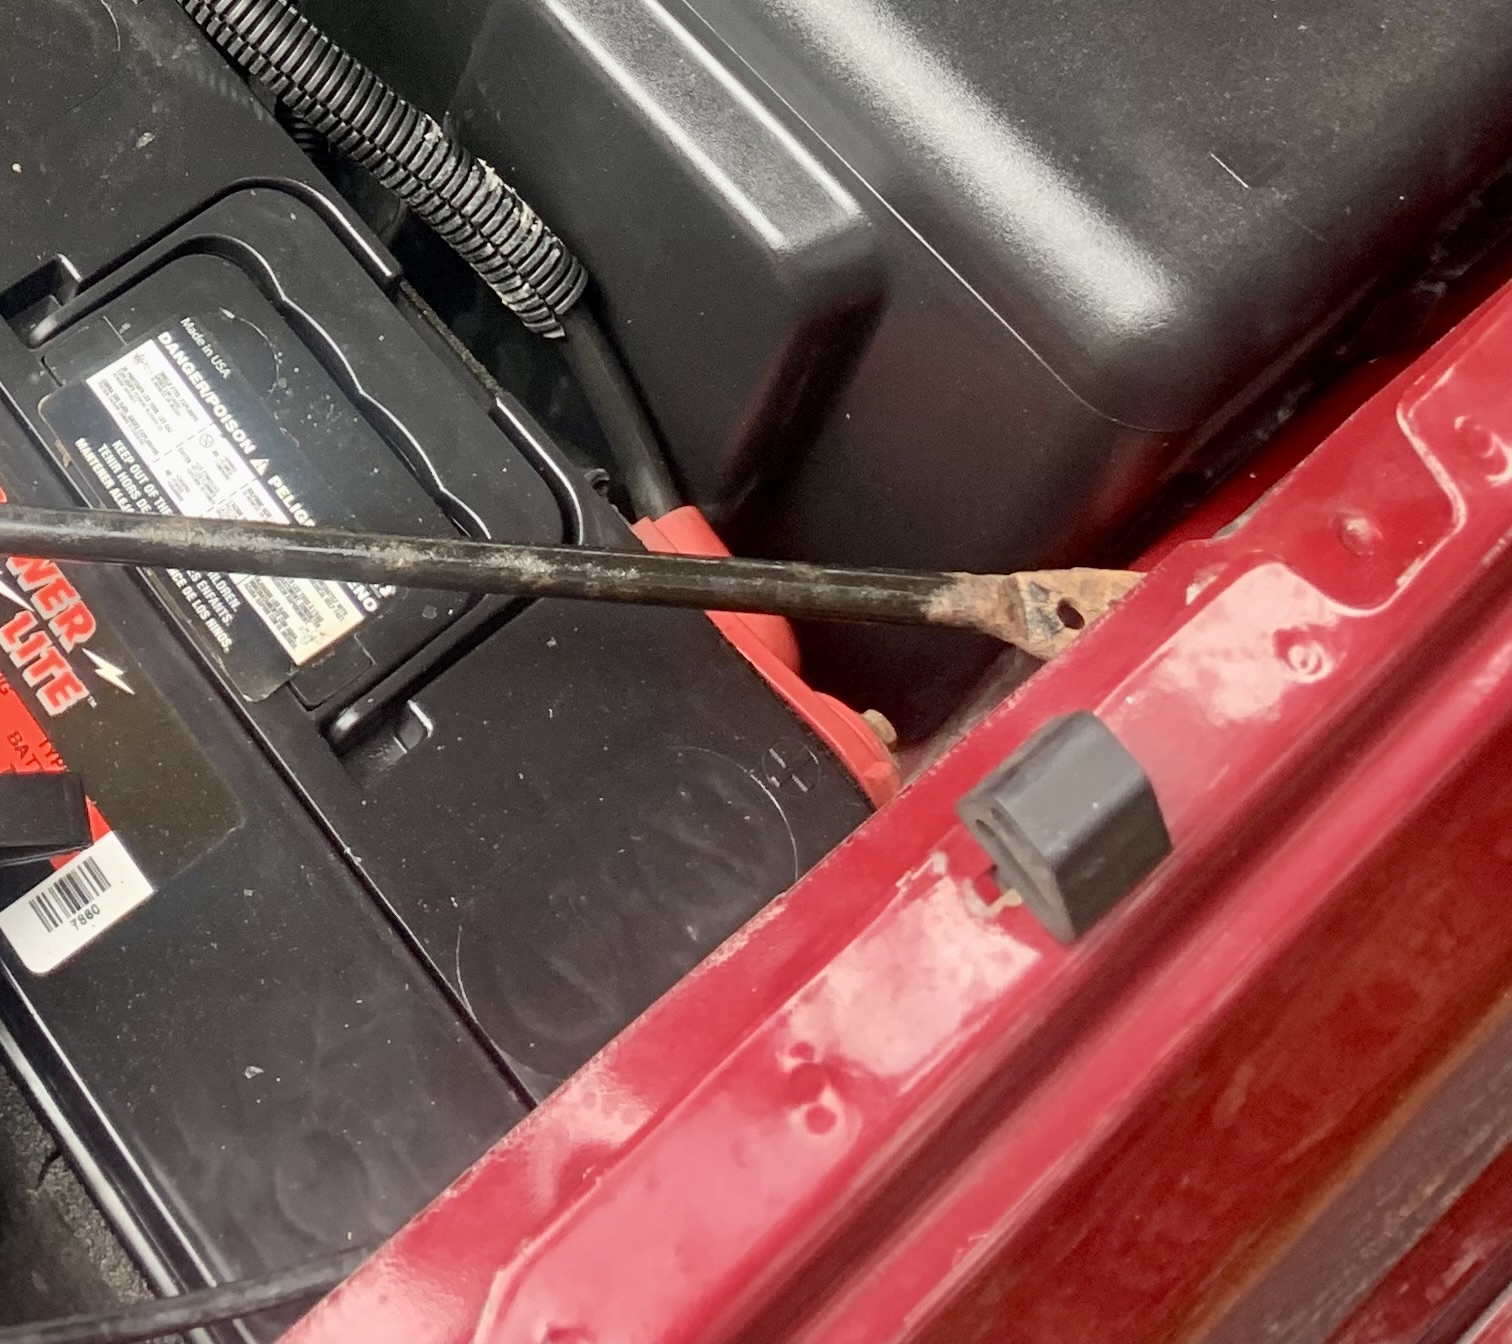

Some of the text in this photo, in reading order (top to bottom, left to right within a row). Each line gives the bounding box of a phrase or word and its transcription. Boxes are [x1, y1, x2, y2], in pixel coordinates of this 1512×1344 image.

[178, 315, 233, 380] Made in USA
[95, 442, 124, 474] TENIR
[114, 469, 143, 501] HORS
[134, 496, 152, 514] DE
[110, 438, 136, 467] KEEP
[127, 462, 150, 486] OUT
[142, 481, 159, 499] OF
[157, 330, 256, 454] DANGER/POISON
[347, 580, 378, 613] ENO
[72, 436, 117, 489] MANTENER
[180, 584, 198, 603] DE
[190, 597, 212, 621] LOS
